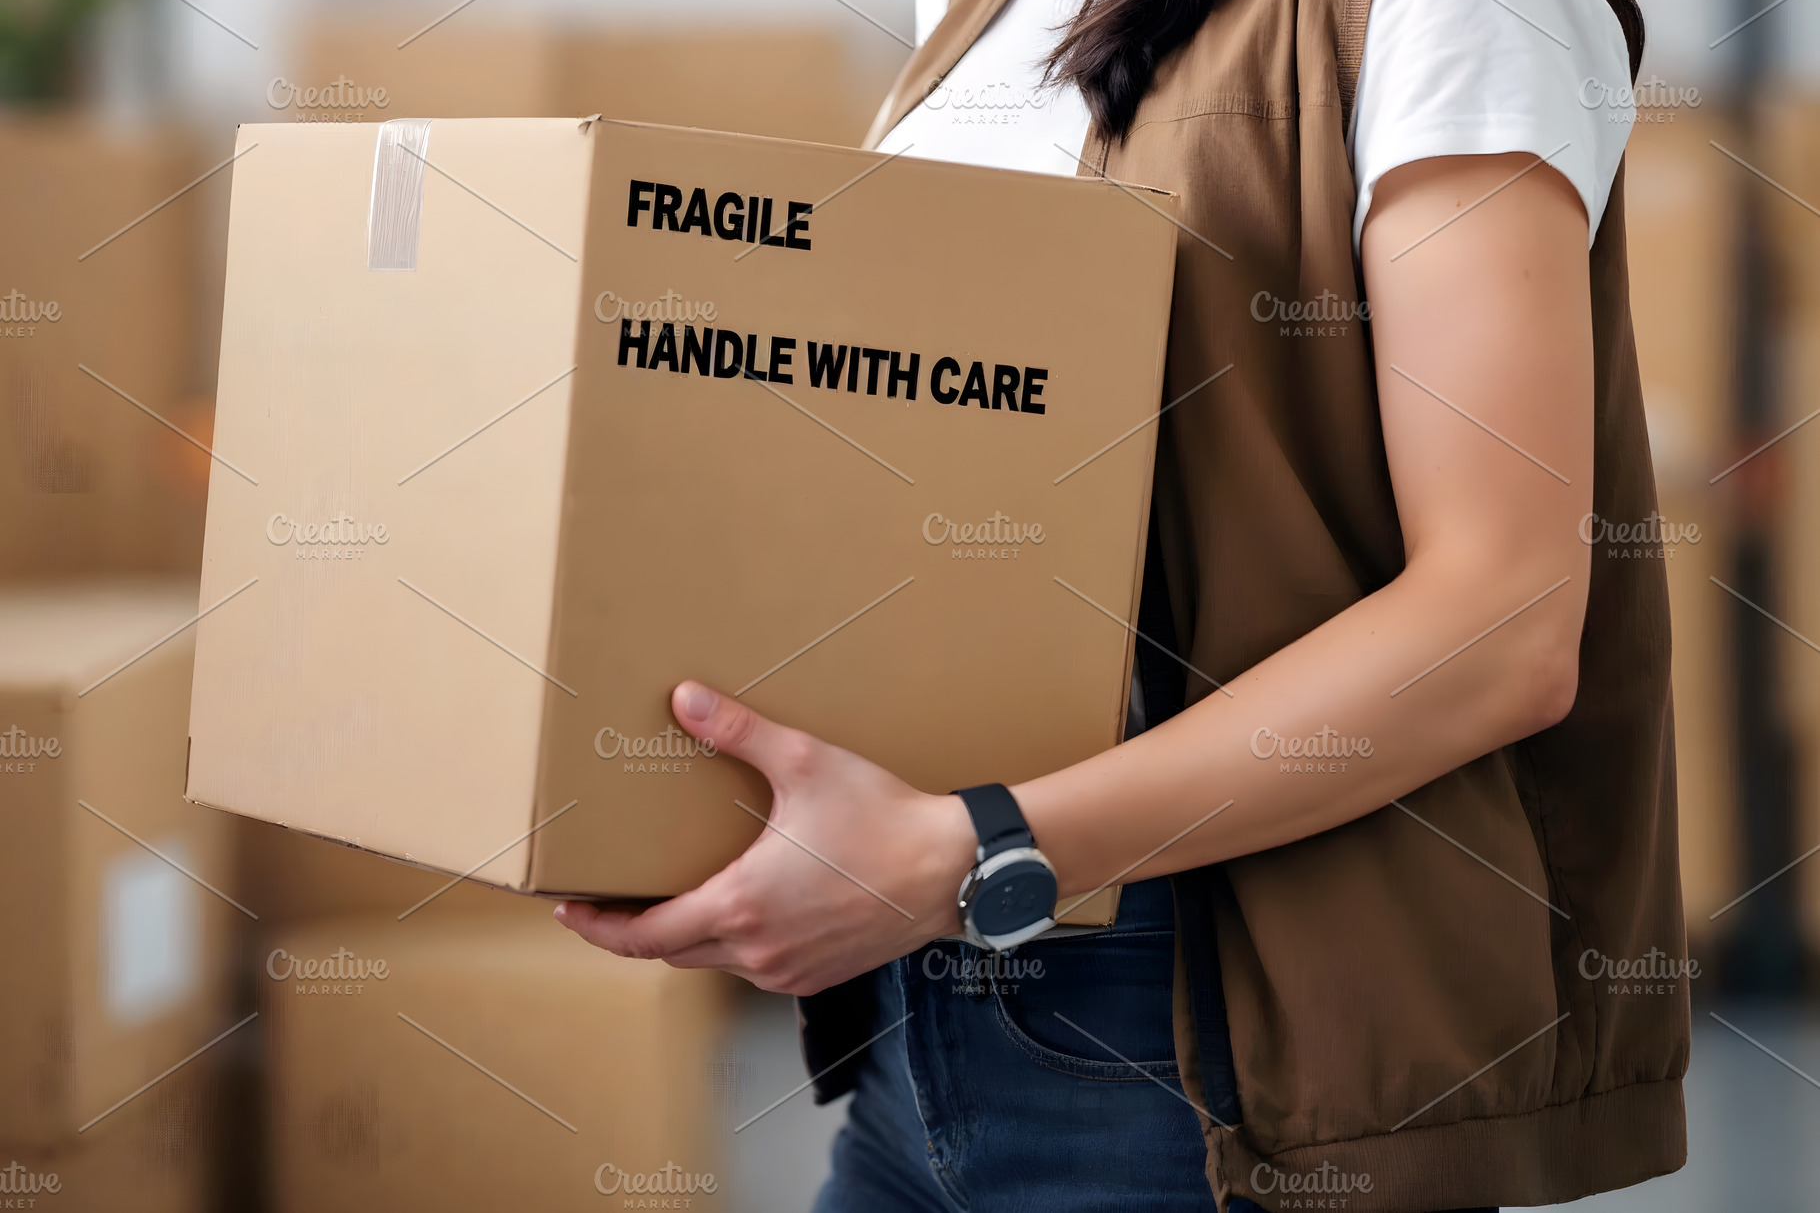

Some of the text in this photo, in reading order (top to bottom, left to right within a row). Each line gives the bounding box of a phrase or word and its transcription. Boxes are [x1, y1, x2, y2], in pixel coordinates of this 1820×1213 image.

[628, 180, 813, 250] FRAGILE
[618, 319, 1048, 414] HANDLE WITH CARE
